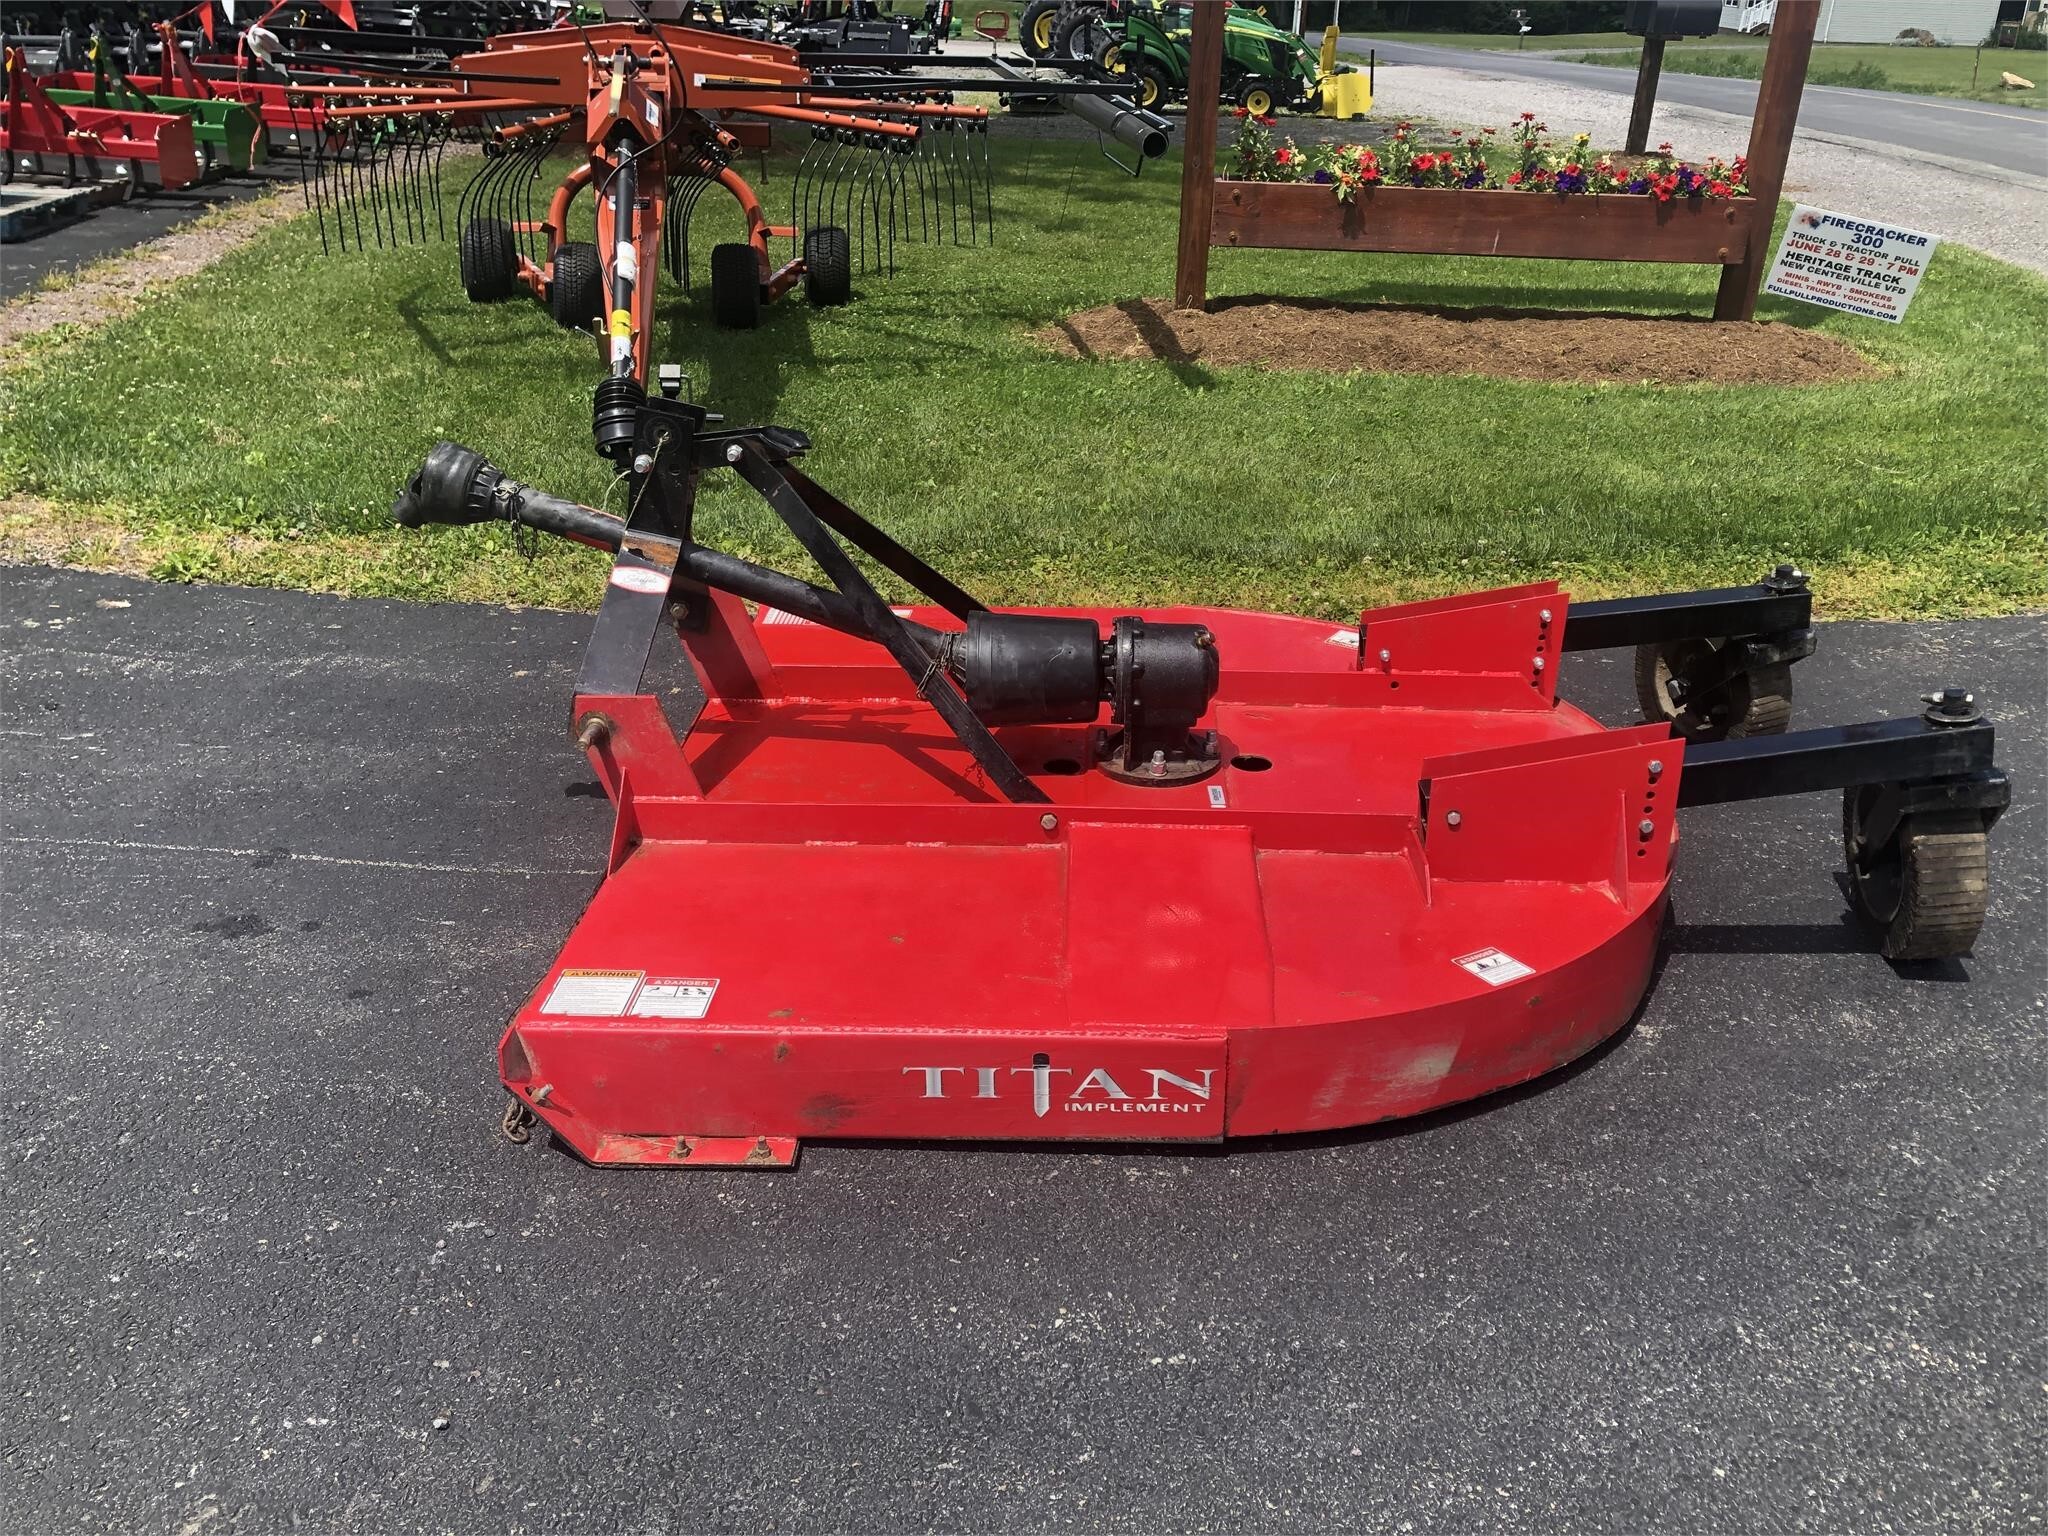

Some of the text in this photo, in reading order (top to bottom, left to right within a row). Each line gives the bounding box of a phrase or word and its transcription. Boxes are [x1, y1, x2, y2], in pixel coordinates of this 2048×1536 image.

[1821, 215, 1928, 247] FIRECRACKER
[1851, 232, 1884, 248] 300
[1786, 239, 1823, 254] JUNE
[1825, 248, 1842, 258] 28
[1844, 252, 1855, 261] &
[1858, 256, 1876, 266] 29
[1886, 262, 1896, 270] 7
[1897, 264, 1919, 276] PM
[1792, 231, 1920, 267] TRUCK & TRACTOR PULL
[1780, 258, 1906, 295] NEW CENTERVILLE VFD
[1785, 250, 1903, 285] HERITAGE TRACK
[1767, 284, 1898, 321] FULLPULLPRODUCTIONS.COM
[1777, 277, 1803, 289] DIESEL
[1806, 284, 1837, 297] TRUCKS
[1843, 294, 1870, 305] YOUTH
[1871, 300, 1897, 311] CLASS
[1784, 271, 1810, 282] MINIS
[1816, 279, 1843, 290] RWYB
[1849, 287, 1893, 302] SMOKERS
[902, 1053, 1219, 1118] TITAN
[1064, 1102, 1207, 1114] IMPLEMENT
